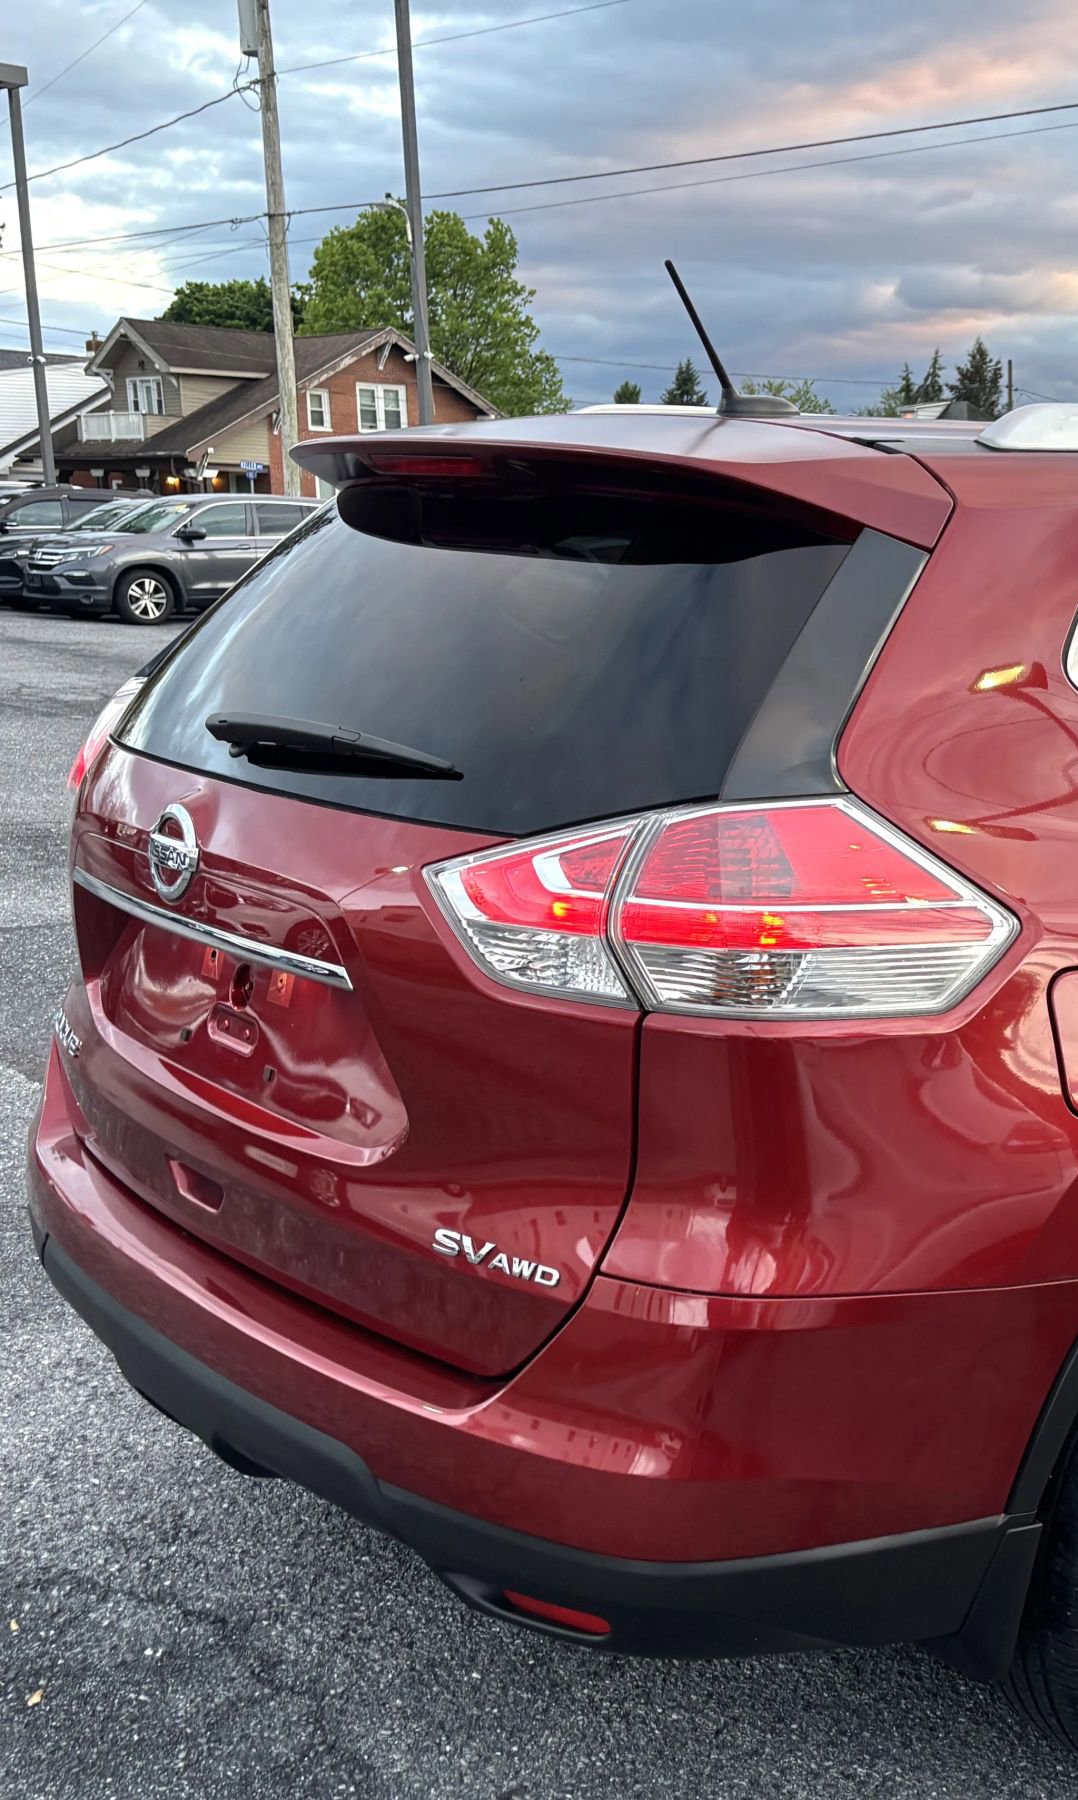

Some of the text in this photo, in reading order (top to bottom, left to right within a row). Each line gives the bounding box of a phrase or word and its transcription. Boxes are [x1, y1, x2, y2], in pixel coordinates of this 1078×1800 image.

[152, 839, 188, 867] SSAN
[432, 1228, 560, 1287] SV AWD
